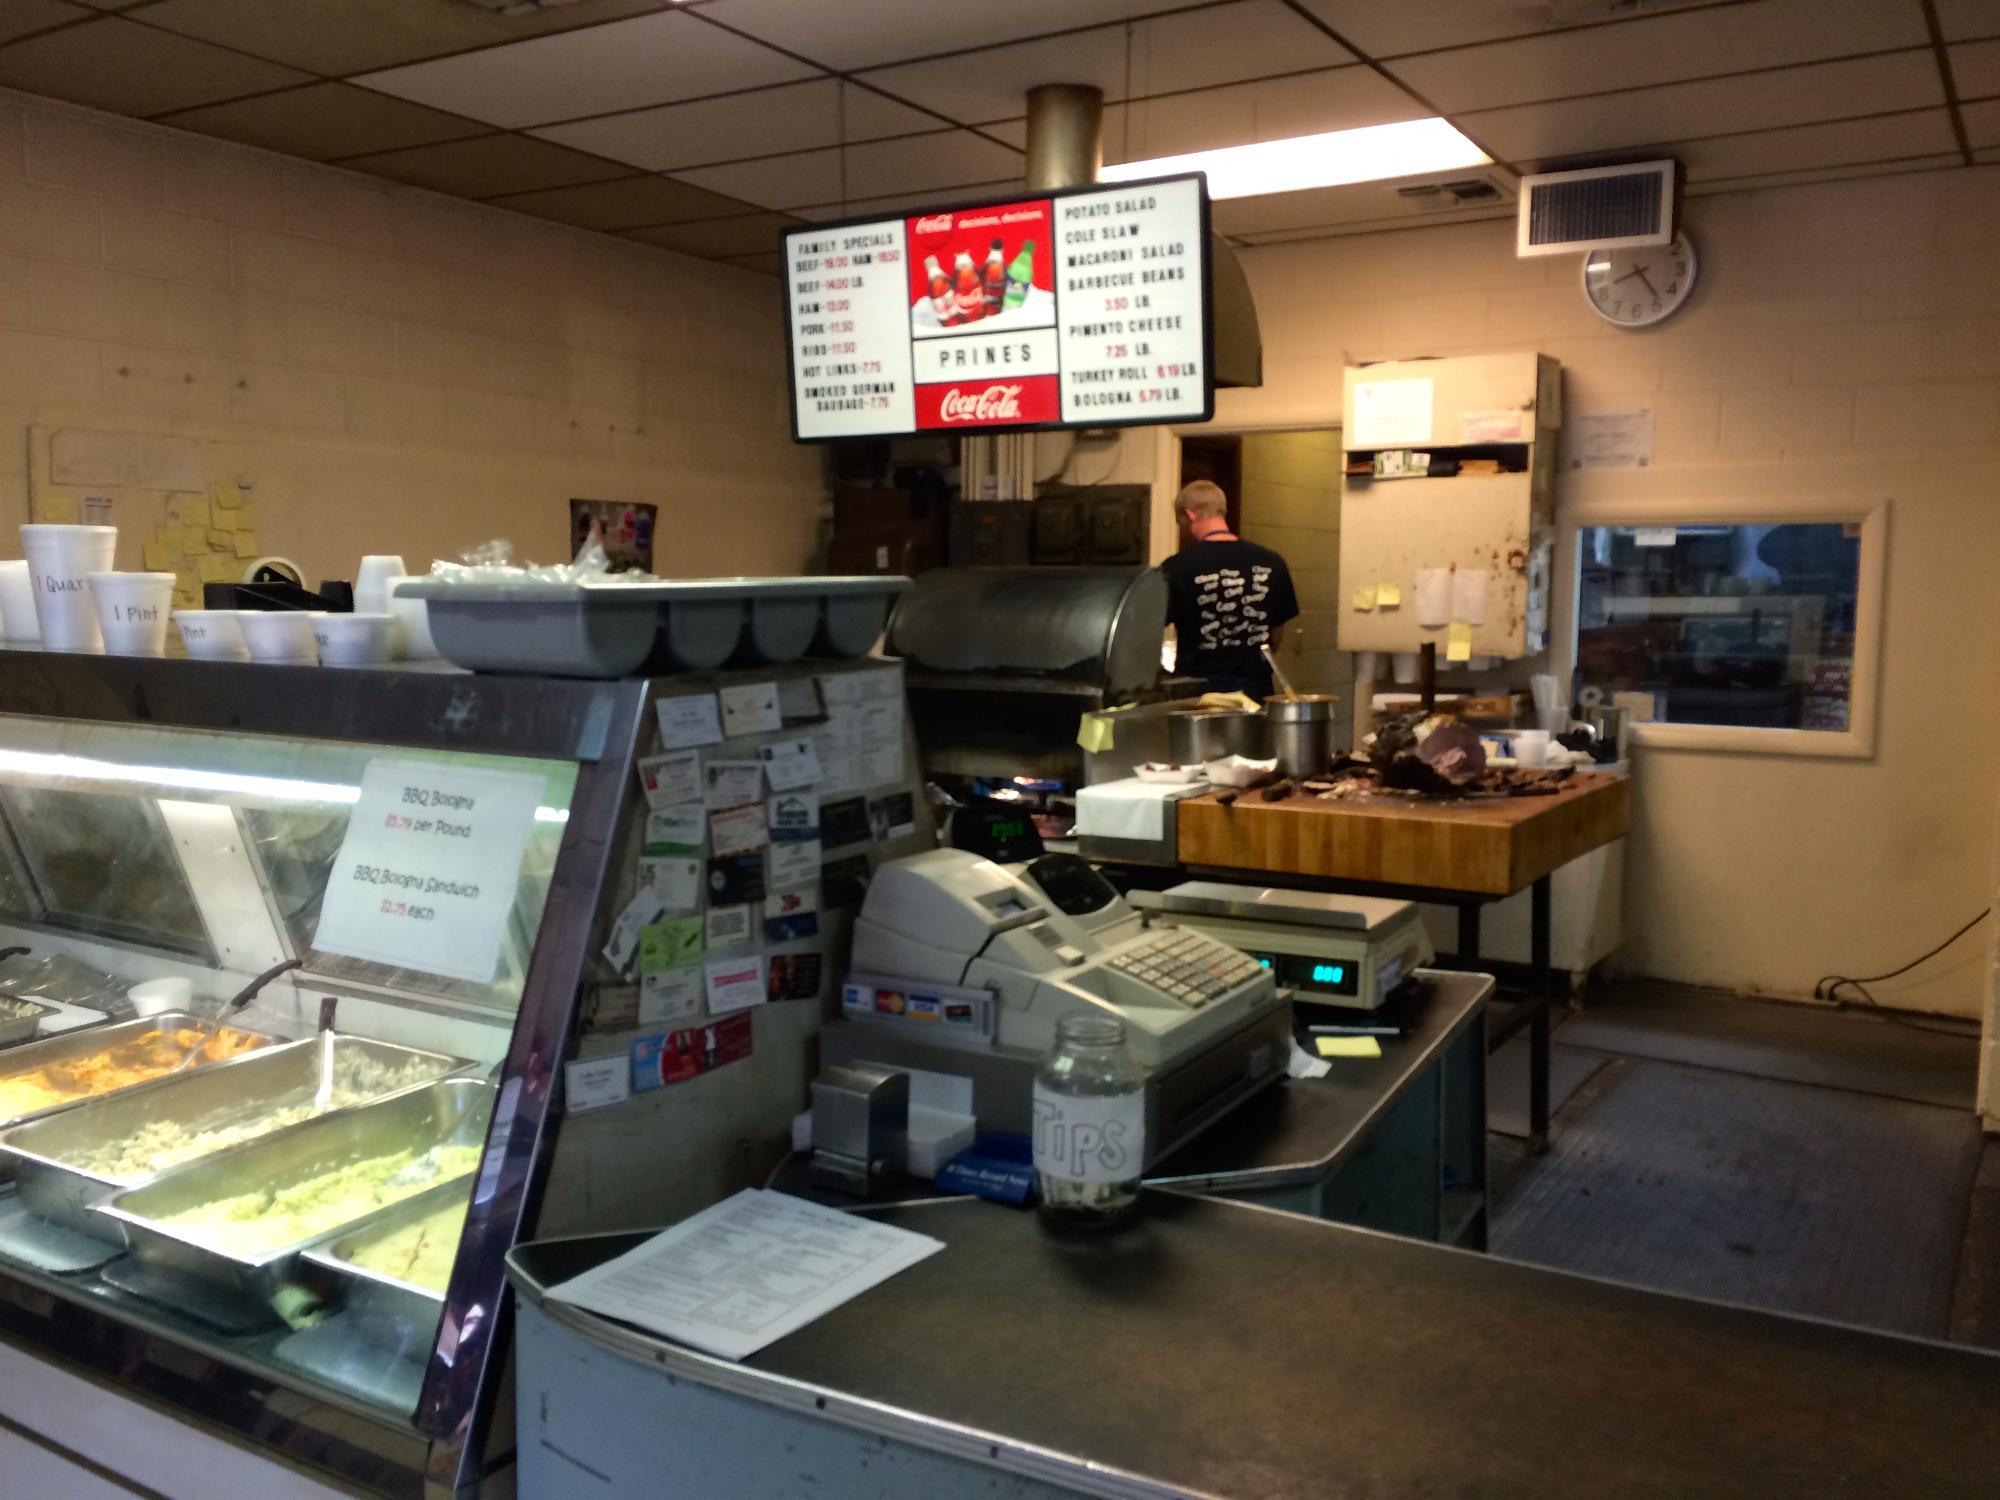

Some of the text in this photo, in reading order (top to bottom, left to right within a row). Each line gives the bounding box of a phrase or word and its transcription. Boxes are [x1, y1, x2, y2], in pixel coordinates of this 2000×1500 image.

[1065, 196, 1156, 219] POTATO SALAD
[798, 233, 893, 254] FAMILY SPECIALS
[1066, 223, 1139, 244] COLE SLAW
[1067, 241, 1184, 267] MACARONI SALAD
[1068, 266, 1184, 291] BARBECUE BEANS
[1675, 261, 1686, 276] 3
[1667, 281, 1678, 295] 4
[1632, 303, 1643, 318] 6
[1069, 315, 1182, 338] PIMENTO CHEESE
[940, 343, 1031, 367] PRINE'S
[803, 366, 820, 378] HOT
[1071, 369, 1113, 384] TURKEY
[1119, 366, 1147, 381] ROLL
[805, 382, 895, 398] SMOKED GERMAN
[1073, 391, 1132, 408] BOLOGNA
[940, 385, 1023, 422] Coca-Cola
[401, 786, 475, 810] BBQ Bologna
[414, 819, 432, 832] per
[434, 819, 471, 838] Pound
[353, 865, 480, 898] BBQ Bologna Sandwich
[407, 904, 434, 920] each
